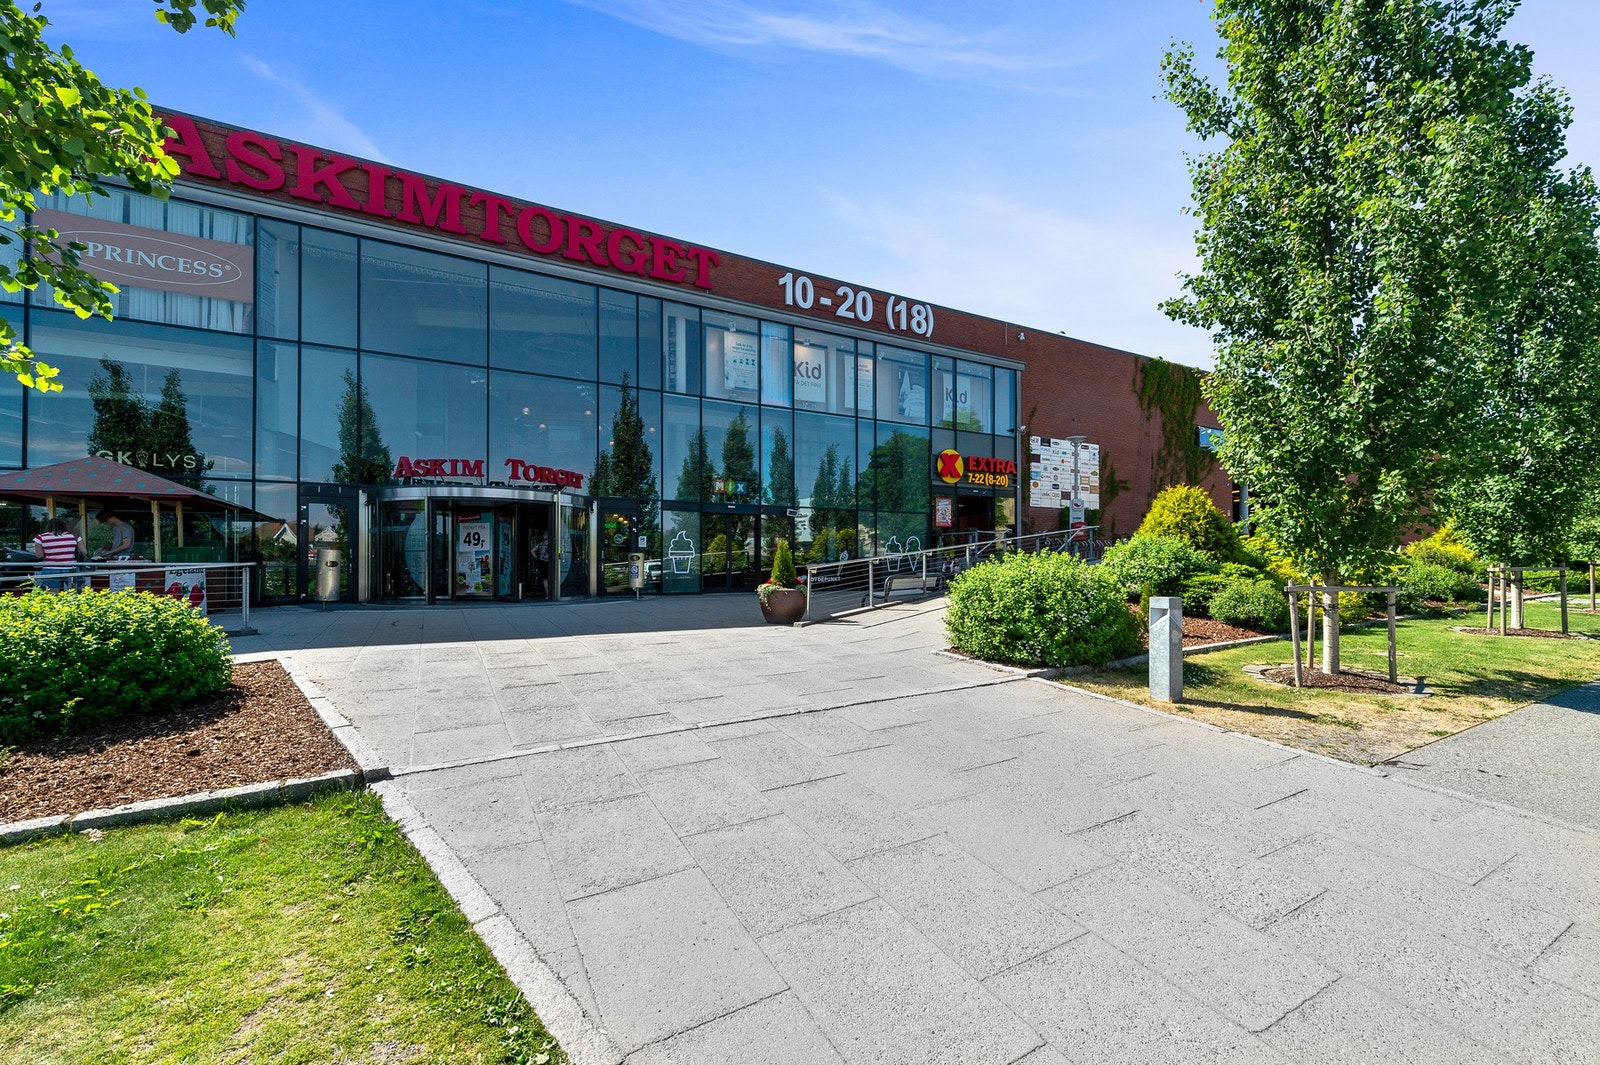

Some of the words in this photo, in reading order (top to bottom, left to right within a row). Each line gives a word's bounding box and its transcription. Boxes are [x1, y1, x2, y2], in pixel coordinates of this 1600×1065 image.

[143, 114, 720, 290] ASKIMTORGET
[885, 295, 935, 338] (18)
[794, 361, 821, 380] Kid
[945, 387, 968, 405] Kd
[152, 453, 196, 469] LYS
[967, 456, 1017, 474] EXTRA
[394, 456, 485, 477] ASKIM
[504, 459, 584, 488] TORGET
[967, 473, 985, 484] 7-22
[985, 472, 1009, 487] (8-20)
[715, 480, 745, 493] MIX
